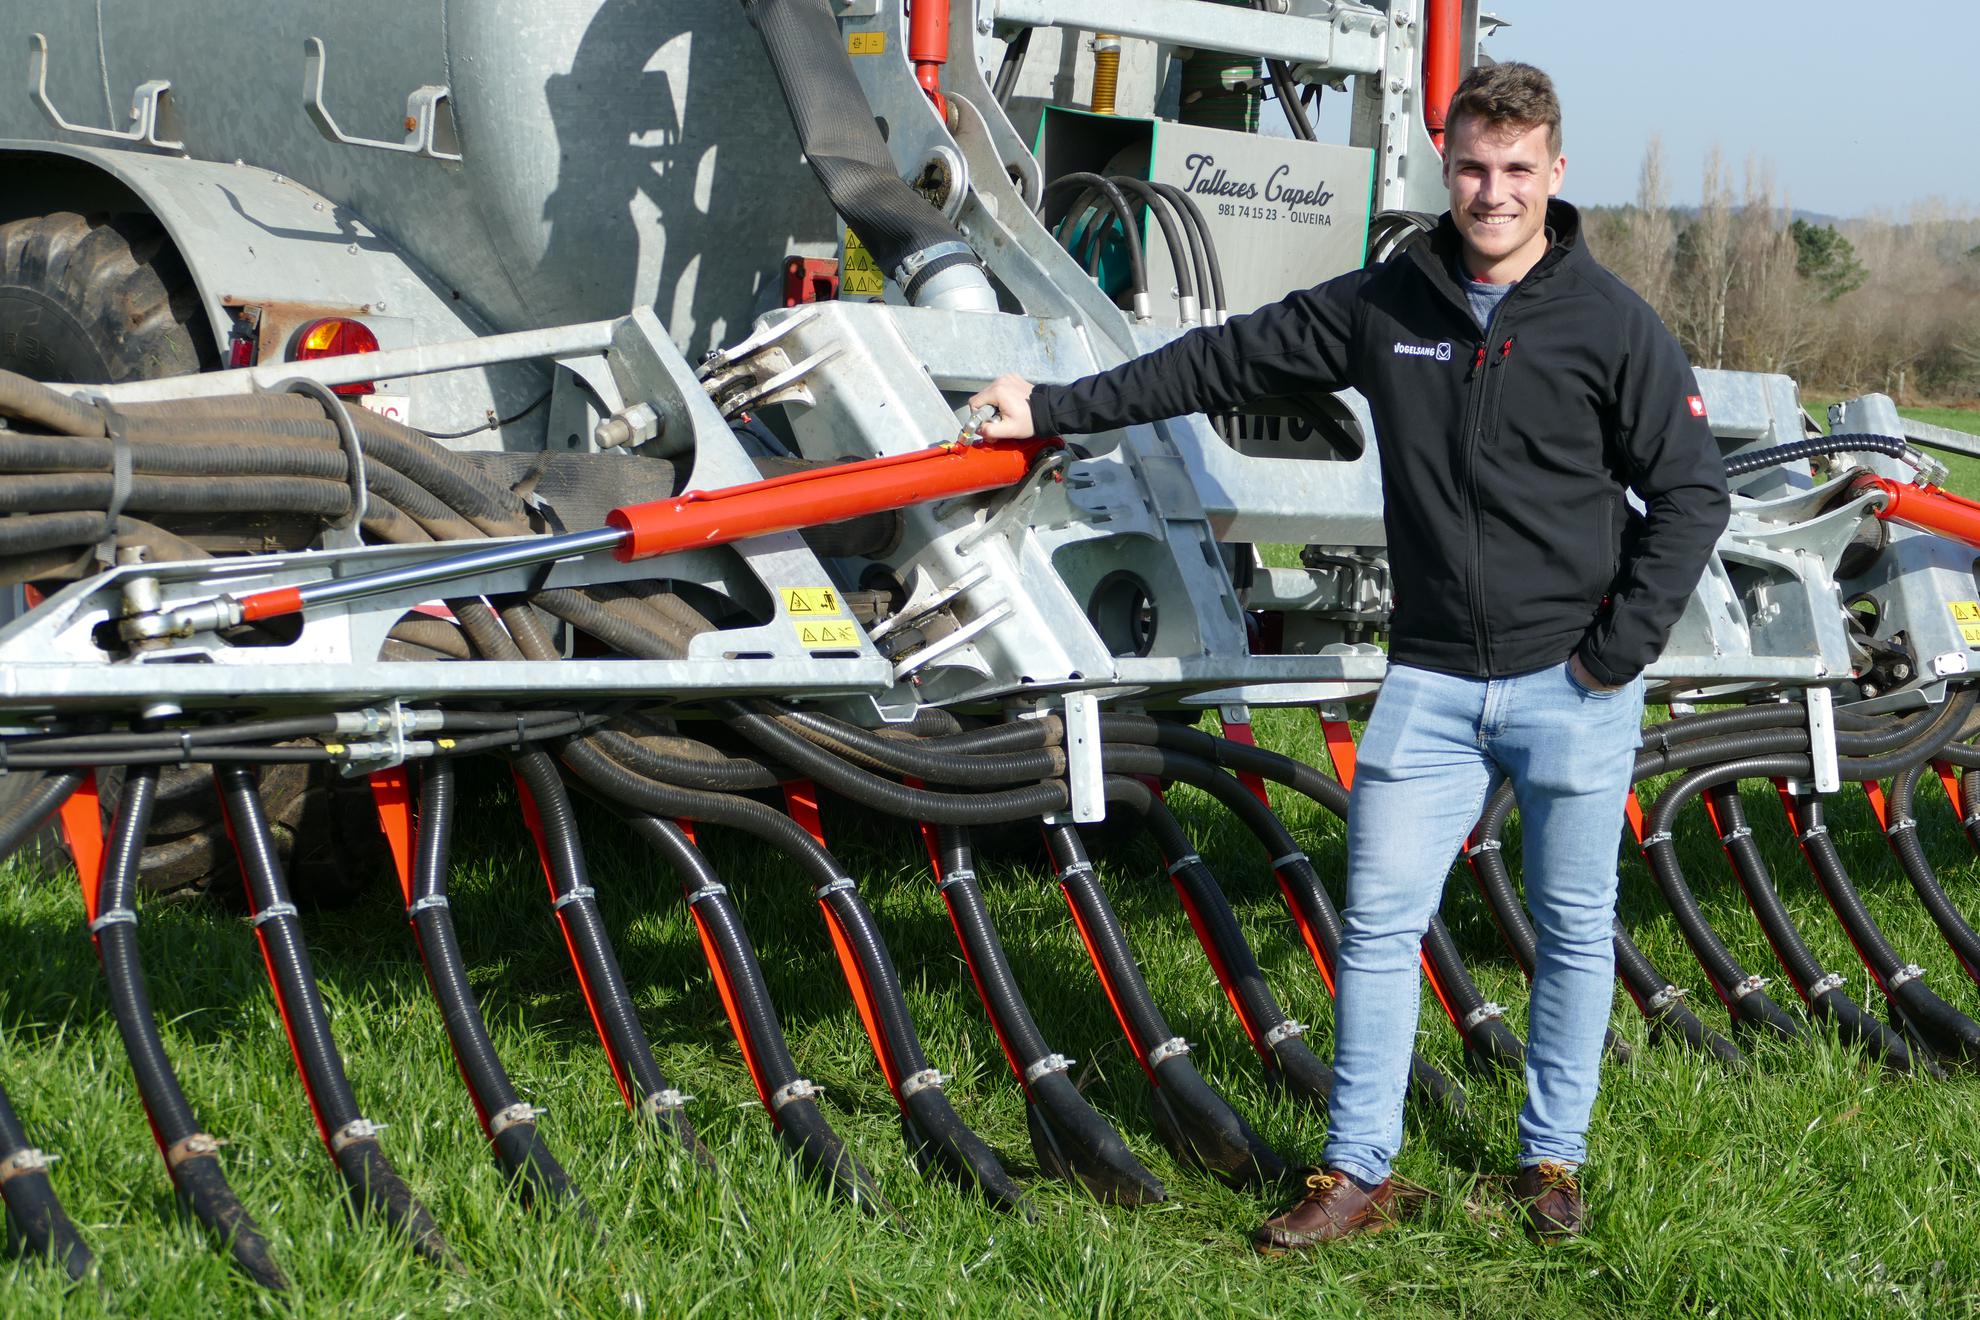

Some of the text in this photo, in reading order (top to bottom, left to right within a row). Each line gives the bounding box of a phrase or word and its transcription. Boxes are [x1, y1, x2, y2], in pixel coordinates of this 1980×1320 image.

[1183, 153, 1334, 212] Talleres Capelo
[1218, 203, 1235, 216] 981
[1238, 205, 1250, 218] 74
[1252, 207, 1263, 219] 15
[1265, 208, 1277, 220] 23
[1290, 211, 1331, 226] OLVEIRA
[1394, 342, 1435, 356] VOGELSANG
